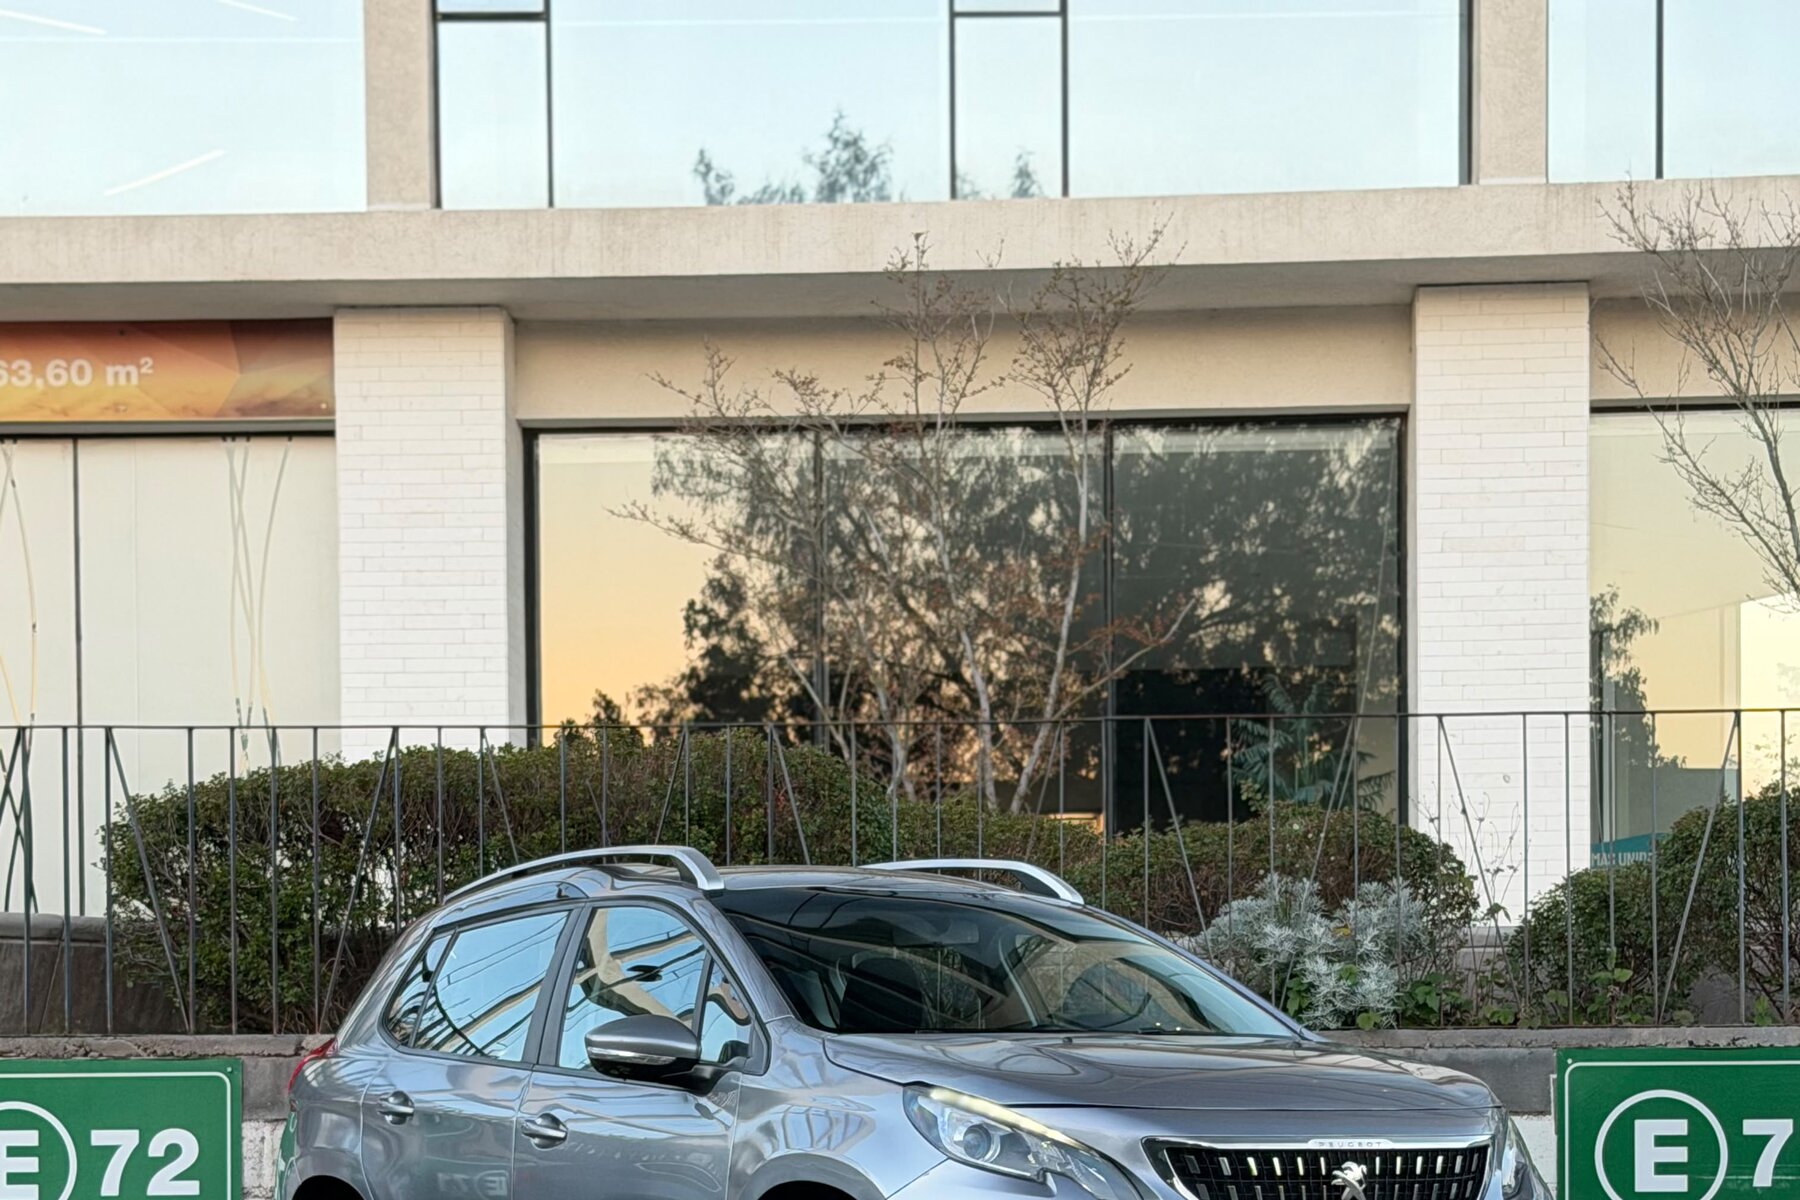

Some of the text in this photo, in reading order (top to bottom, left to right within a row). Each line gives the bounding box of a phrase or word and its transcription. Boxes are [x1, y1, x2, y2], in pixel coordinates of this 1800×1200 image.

[90, 1128, 200, 1196] 72
[1634, 1119, 1793, 1192] E 7
